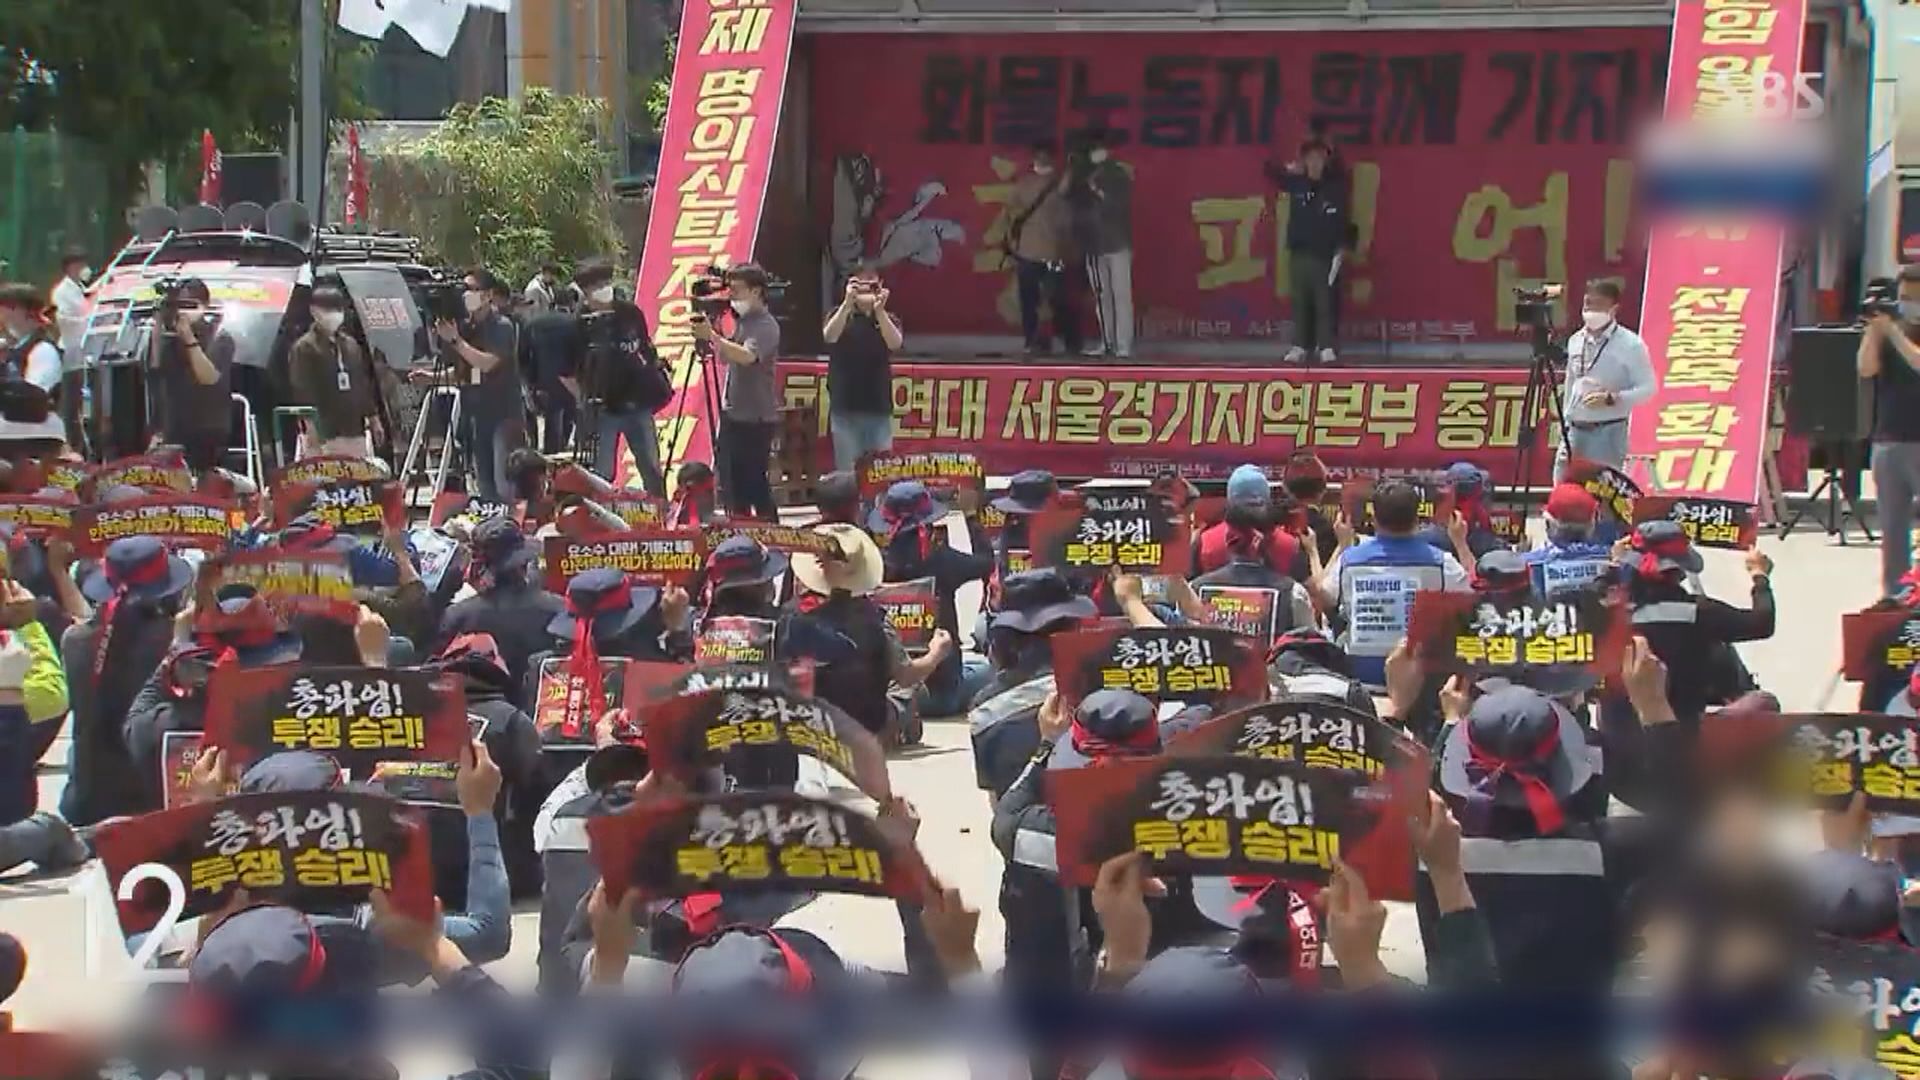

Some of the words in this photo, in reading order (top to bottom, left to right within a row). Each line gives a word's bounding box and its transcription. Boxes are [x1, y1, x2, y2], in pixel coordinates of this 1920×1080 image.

[1002, 377, 1422, 450] 서울경기지역본부
[1648, 402, 1741, 492] 확대
[1076, 518, 1151, 545] 총파업!
[1066, 544, 1113, 566] 투쟁
[1117, 543, 1163, 566] 승리!
[1470, 601, 1577, 639] 총파업!
[1112, 637, 1213, 667] 총파업!
[1455, 635, 1518, 666] 투쟁
[1525, 633, 1595, 664] 승리!
[287, 678, 403, 718] 총파업!
[1166, 665, 1232, 692] 승리!
[272, 715, 343, 750] 투쟁
[350, 715, 425, 750] 승리!
[1237, 710, 1366, 754] 총파업!
[1152, 770, 1314, 826] 총파업!
[204, 801, 365, 855] 총파업!
[689, 803, 851, 849] 총파업!
[1132, 819, 1231, 861] 투쟁
[191, 849, 286, 894] 투쟁
[294, 846, 393, 891] 승리!
[675, 844, 771, 883] 투쟁
[779, 845, 884, 884] 승리!
